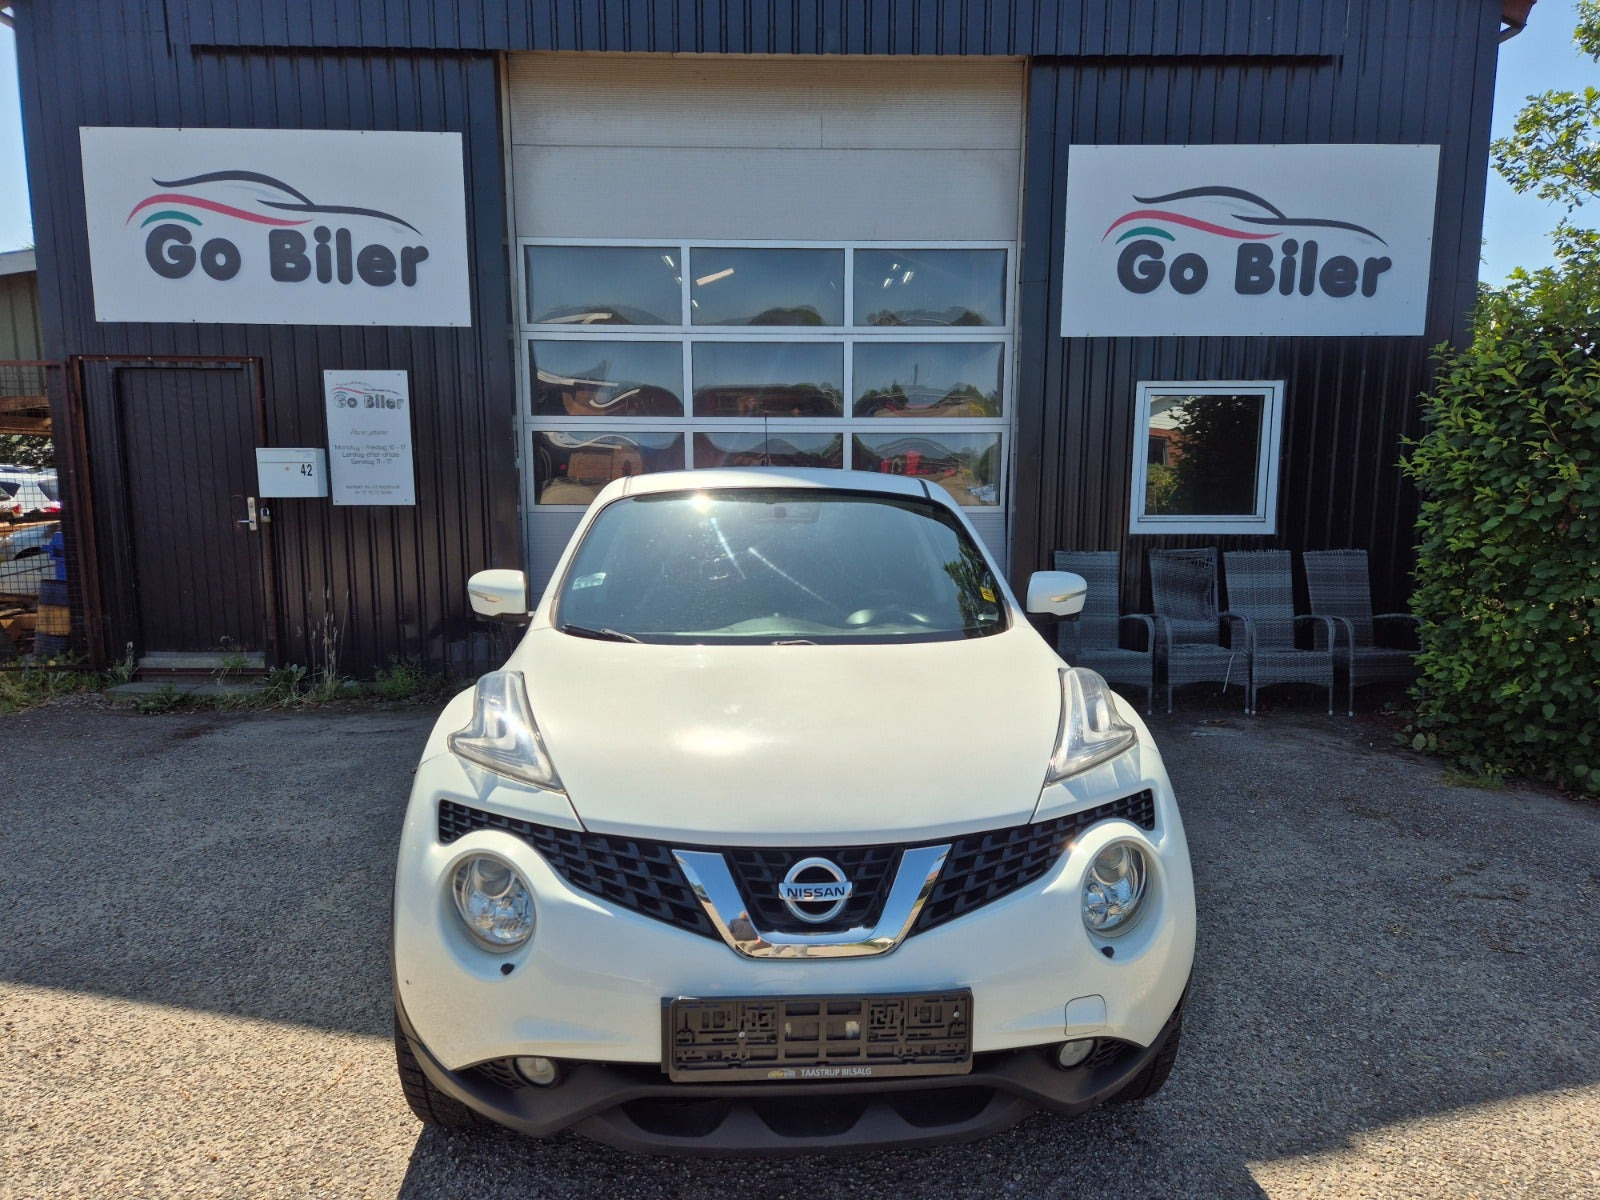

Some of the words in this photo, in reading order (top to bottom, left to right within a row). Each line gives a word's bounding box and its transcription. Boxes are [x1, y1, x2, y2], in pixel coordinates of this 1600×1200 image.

[145, 223, 242, 281] Go
[268, 225, 430, 287] Biler
[1117, 239, 1209, 295] Go
[1234, 238, 1393, 298] Biler
[334, 394, 358, 409] Go
[363, 394, 405, 410] Biler
[300, 463, 313, 477] 42
[786, 886, 846, 898] NISSAN
[800, 1068, 840, 1077] TAASTRUP
[841, 1067, 872, 1076] BILSALG
